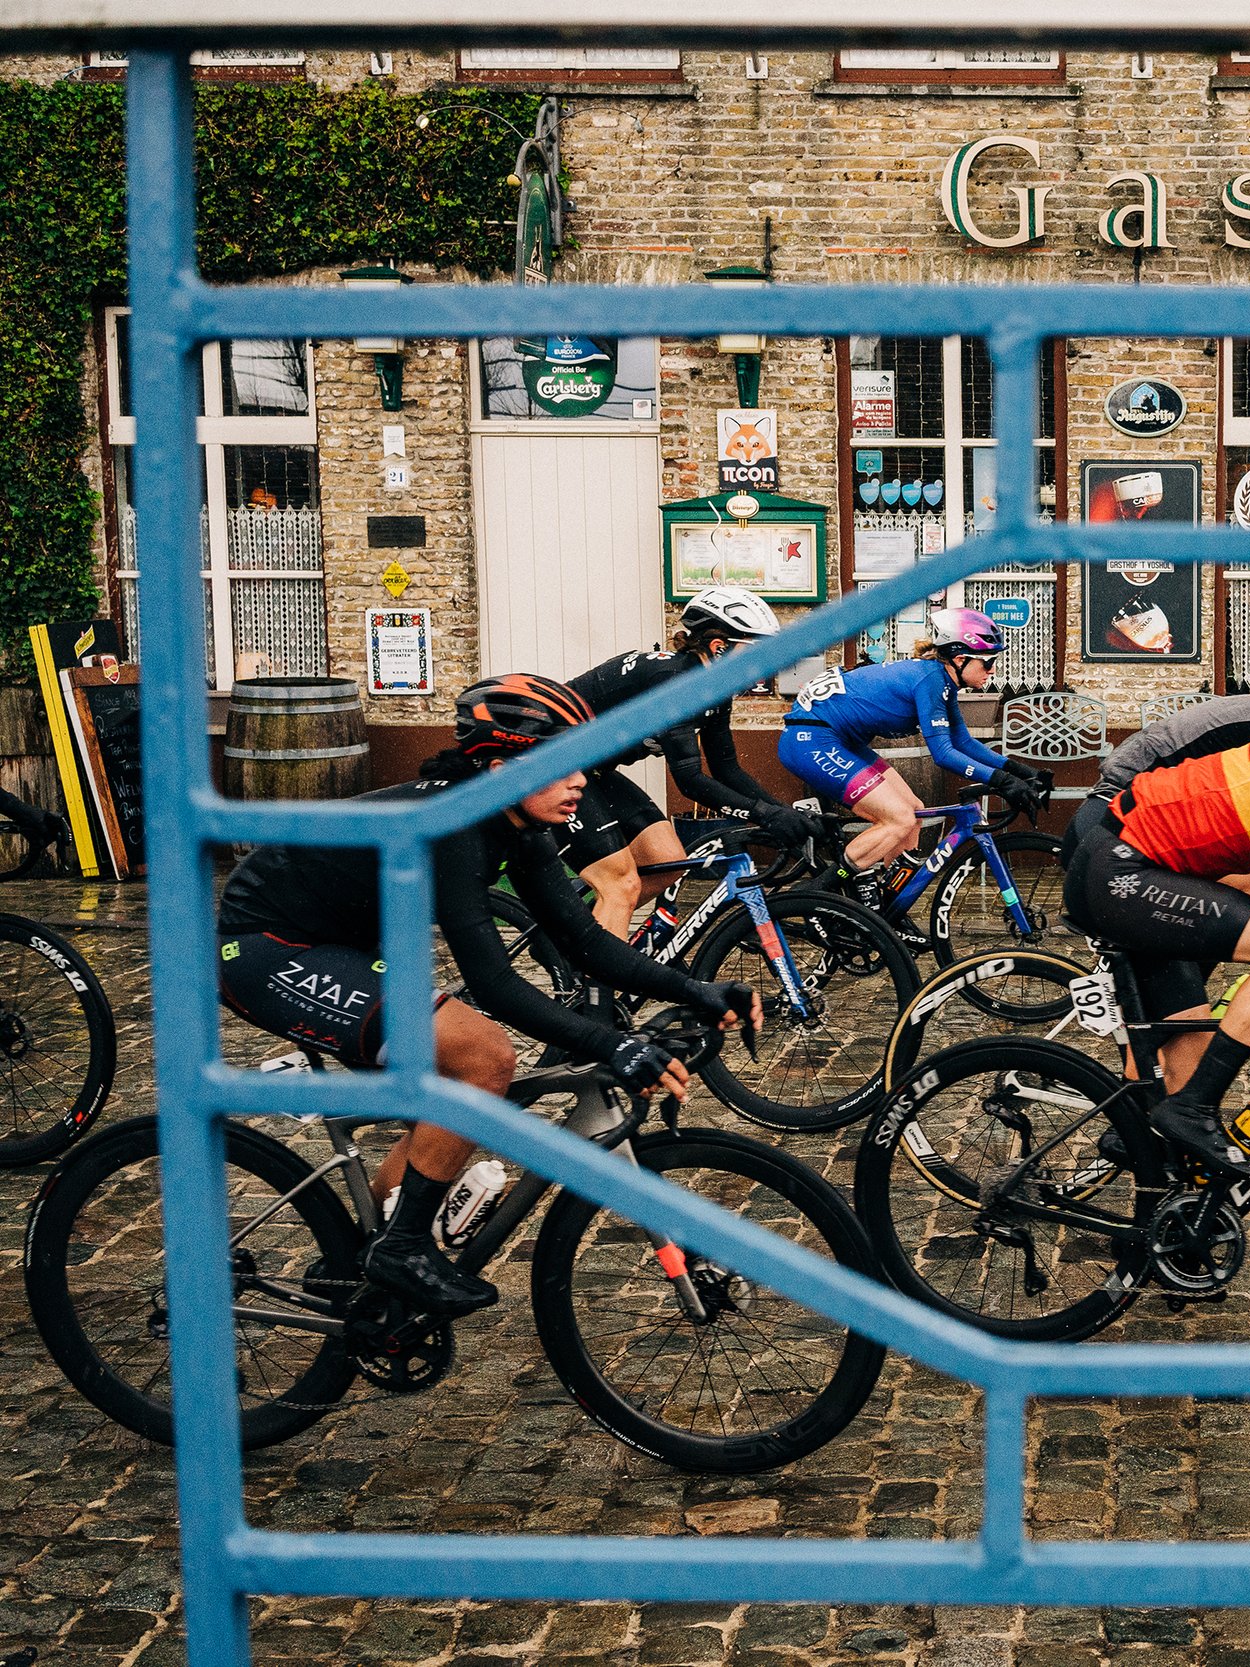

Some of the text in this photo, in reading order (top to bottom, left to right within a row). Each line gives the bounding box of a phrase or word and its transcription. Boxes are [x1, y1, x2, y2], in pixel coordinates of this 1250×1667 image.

[552, 366, 587, 374] Official Bar
[536, 376, 603, 403] Carlsberg
[852, 385, 892, 393] verisure
[854, 400, 892, 411] Alarme
[1116, 408, 1176, 424] Augustijn
[1109, 561, 1138, 569] GASTHOF
[1010, 612, 1025, 621] MEE
[491, 730, 537, 744] RUDY
[810, 750, 849, 782] ALULA
[925, 841, 954, 874] Liv
[936, 857, 976, 940] CADEX
[1141, 884, 1228, 919] REITAN
[1151, 910, 1196, 928] RETAIL
[29, 936, 89, 993] DT SWISS
[266, 982, 352, 1027] CYCLING TEAM
[1072, 979, 1106, 1022] 192
[911, 1069, 941, 1100] DT
[875, 1094, 914, 1150] SWISS
